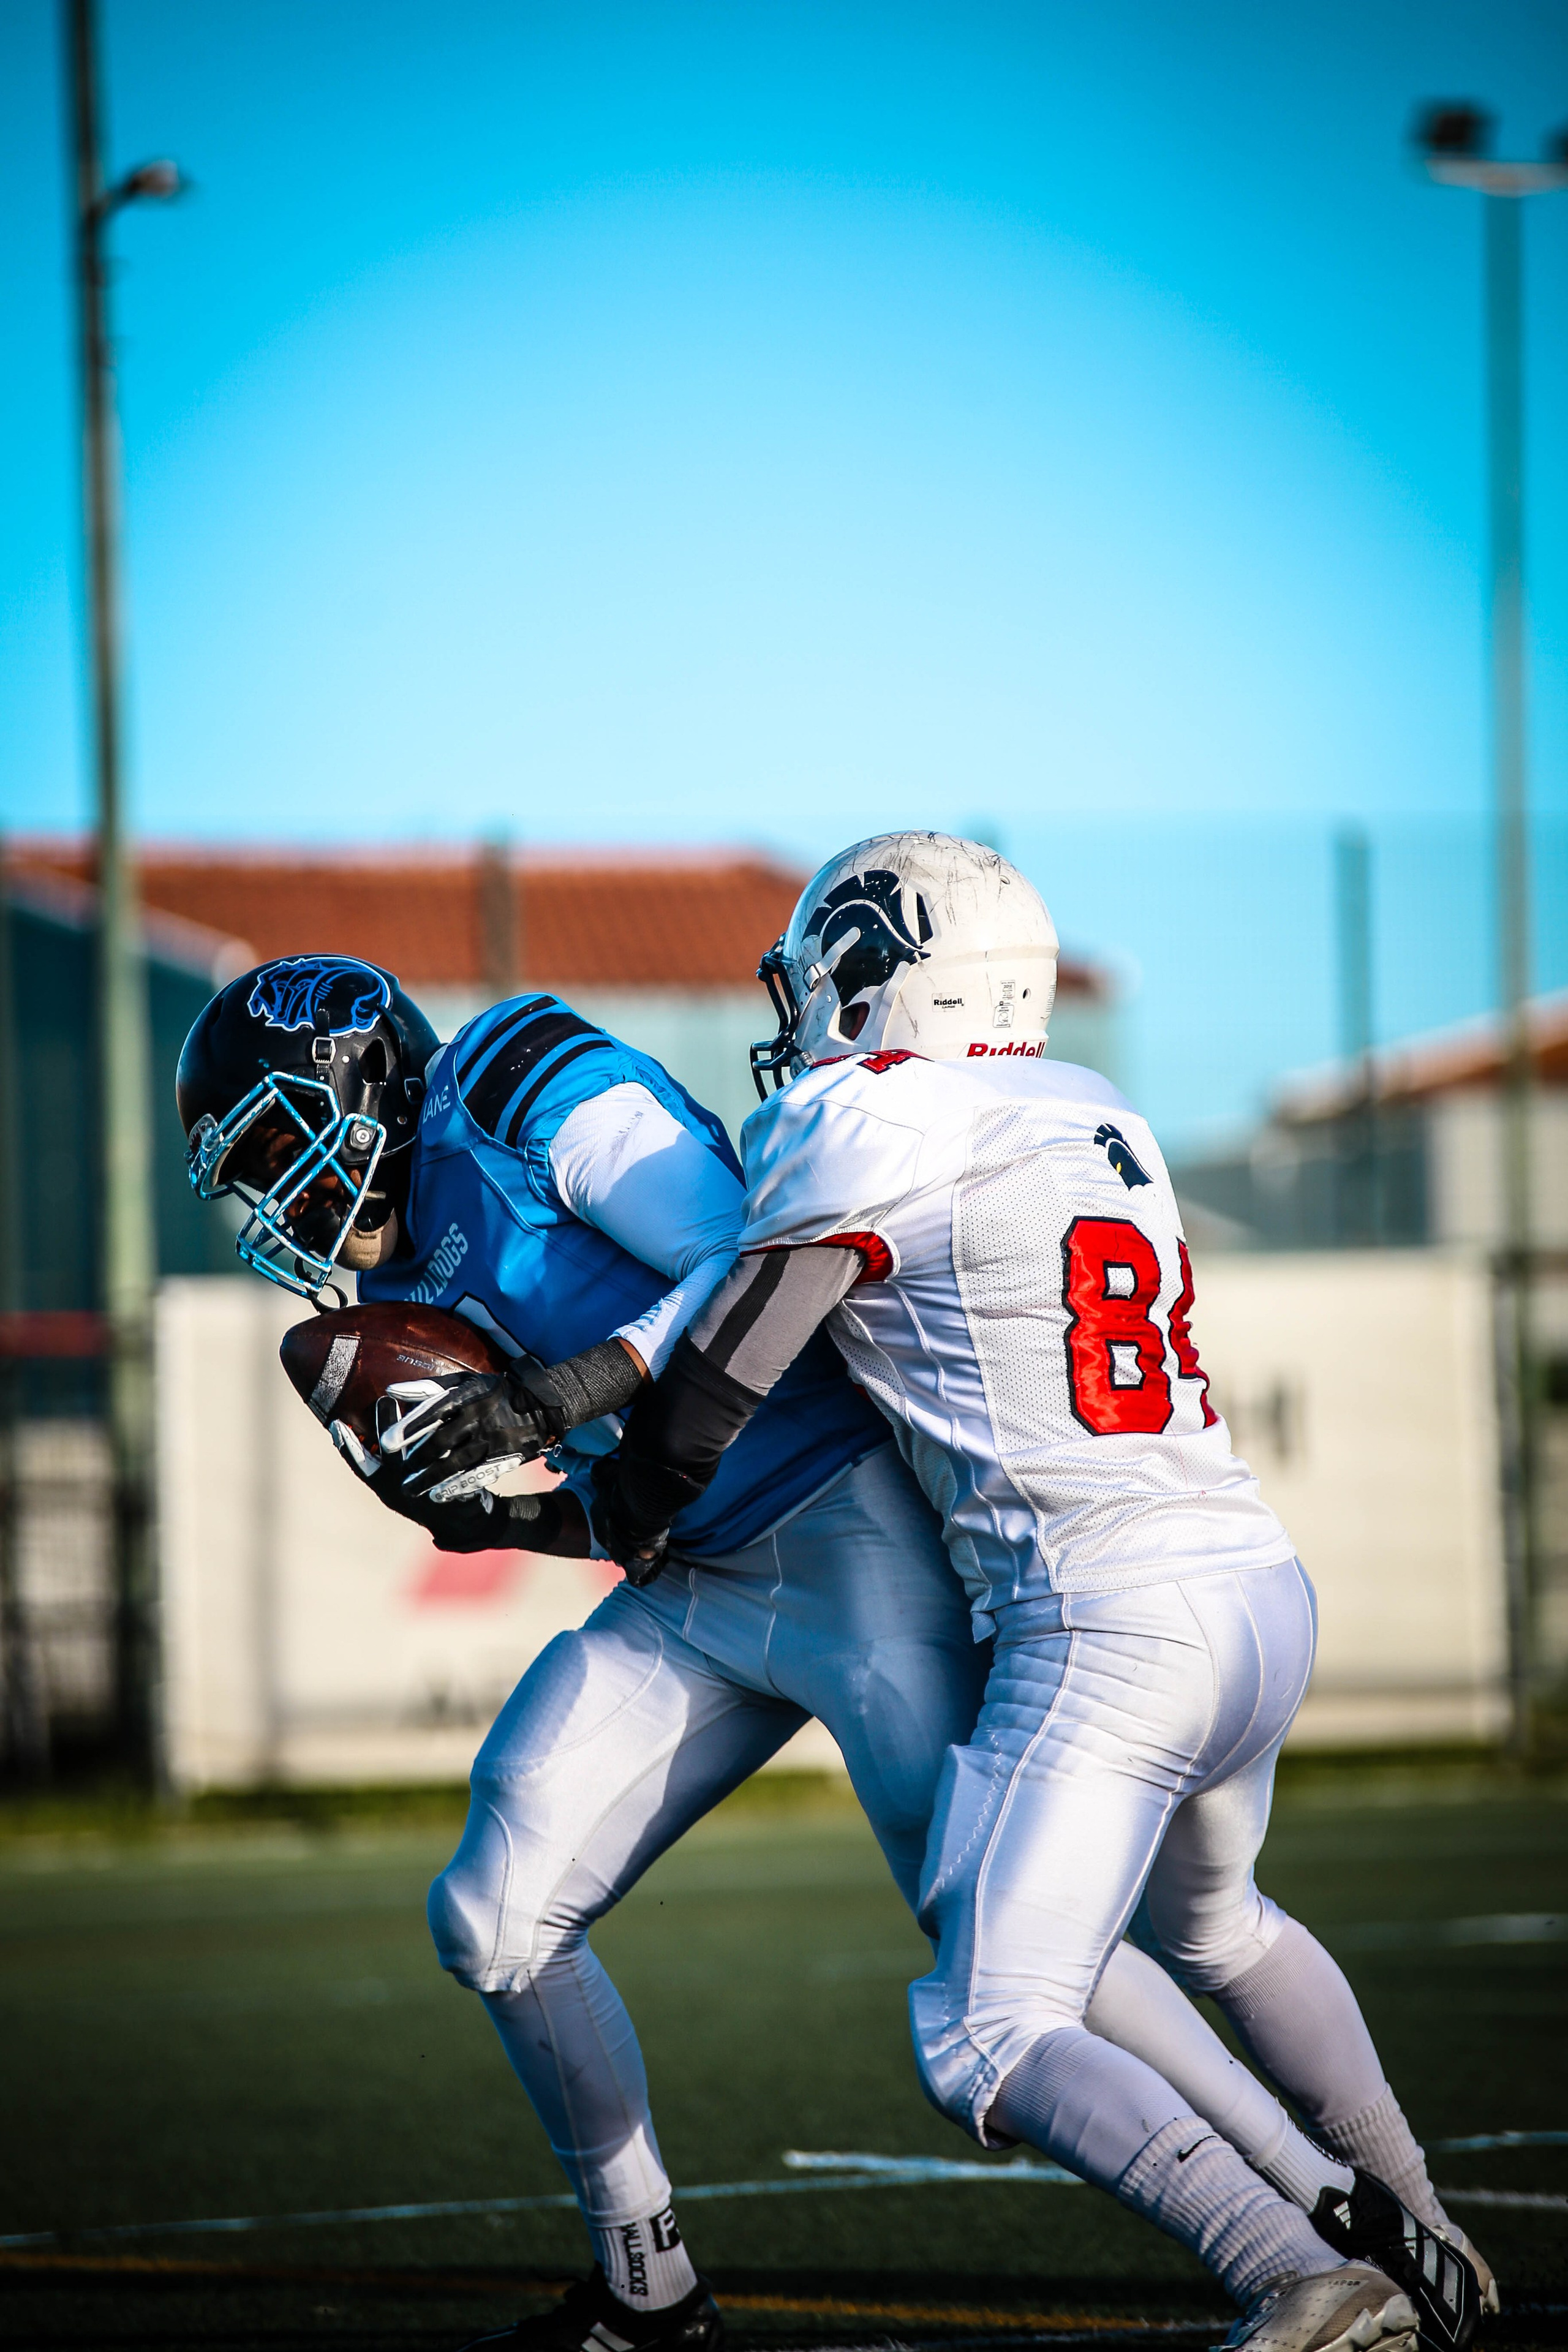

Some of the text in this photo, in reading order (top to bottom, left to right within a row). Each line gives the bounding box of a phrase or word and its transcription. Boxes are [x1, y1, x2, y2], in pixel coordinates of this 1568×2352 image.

[404, 1223, 468, 1305] ULLDOGS
[435, 1464, 500, 1500] GRIP BOOST
